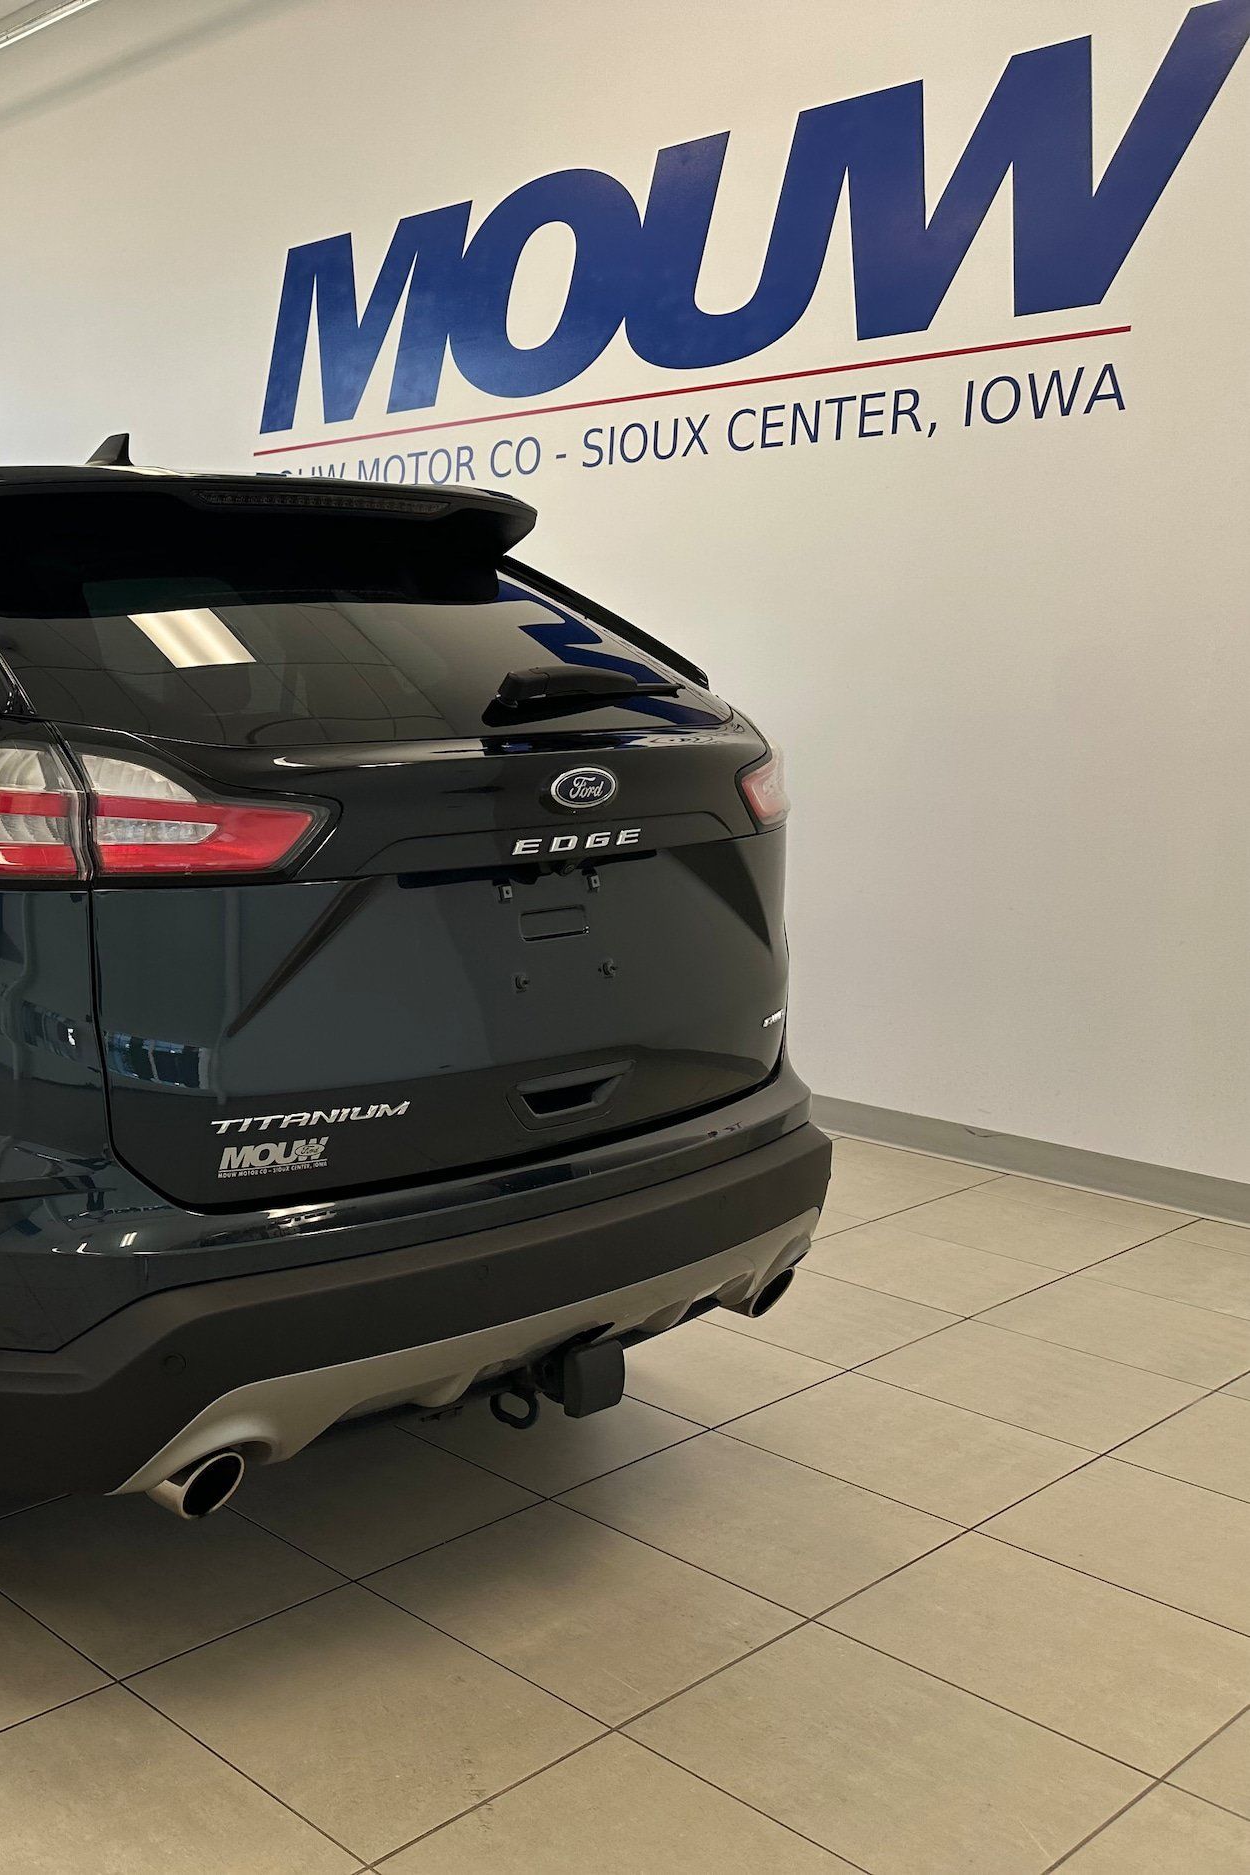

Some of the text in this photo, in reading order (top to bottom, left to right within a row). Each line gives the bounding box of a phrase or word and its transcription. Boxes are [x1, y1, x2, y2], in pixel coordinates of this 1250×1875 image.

[259, 0, 1250, 434] MOUW
[358, 446, 475, 486] MOTOR
[490, 437, 541, 478] CO
[582, 414, 709, 468] SIOUX
[727, 388, 938, 453] CENTER,
[963, 363, 1126, 427] IOWA
[569, 776, 605, 800] Ford
[511, 828, 642, 856] EDGE
[210, 1100, 411, 1135] TITANIUM
